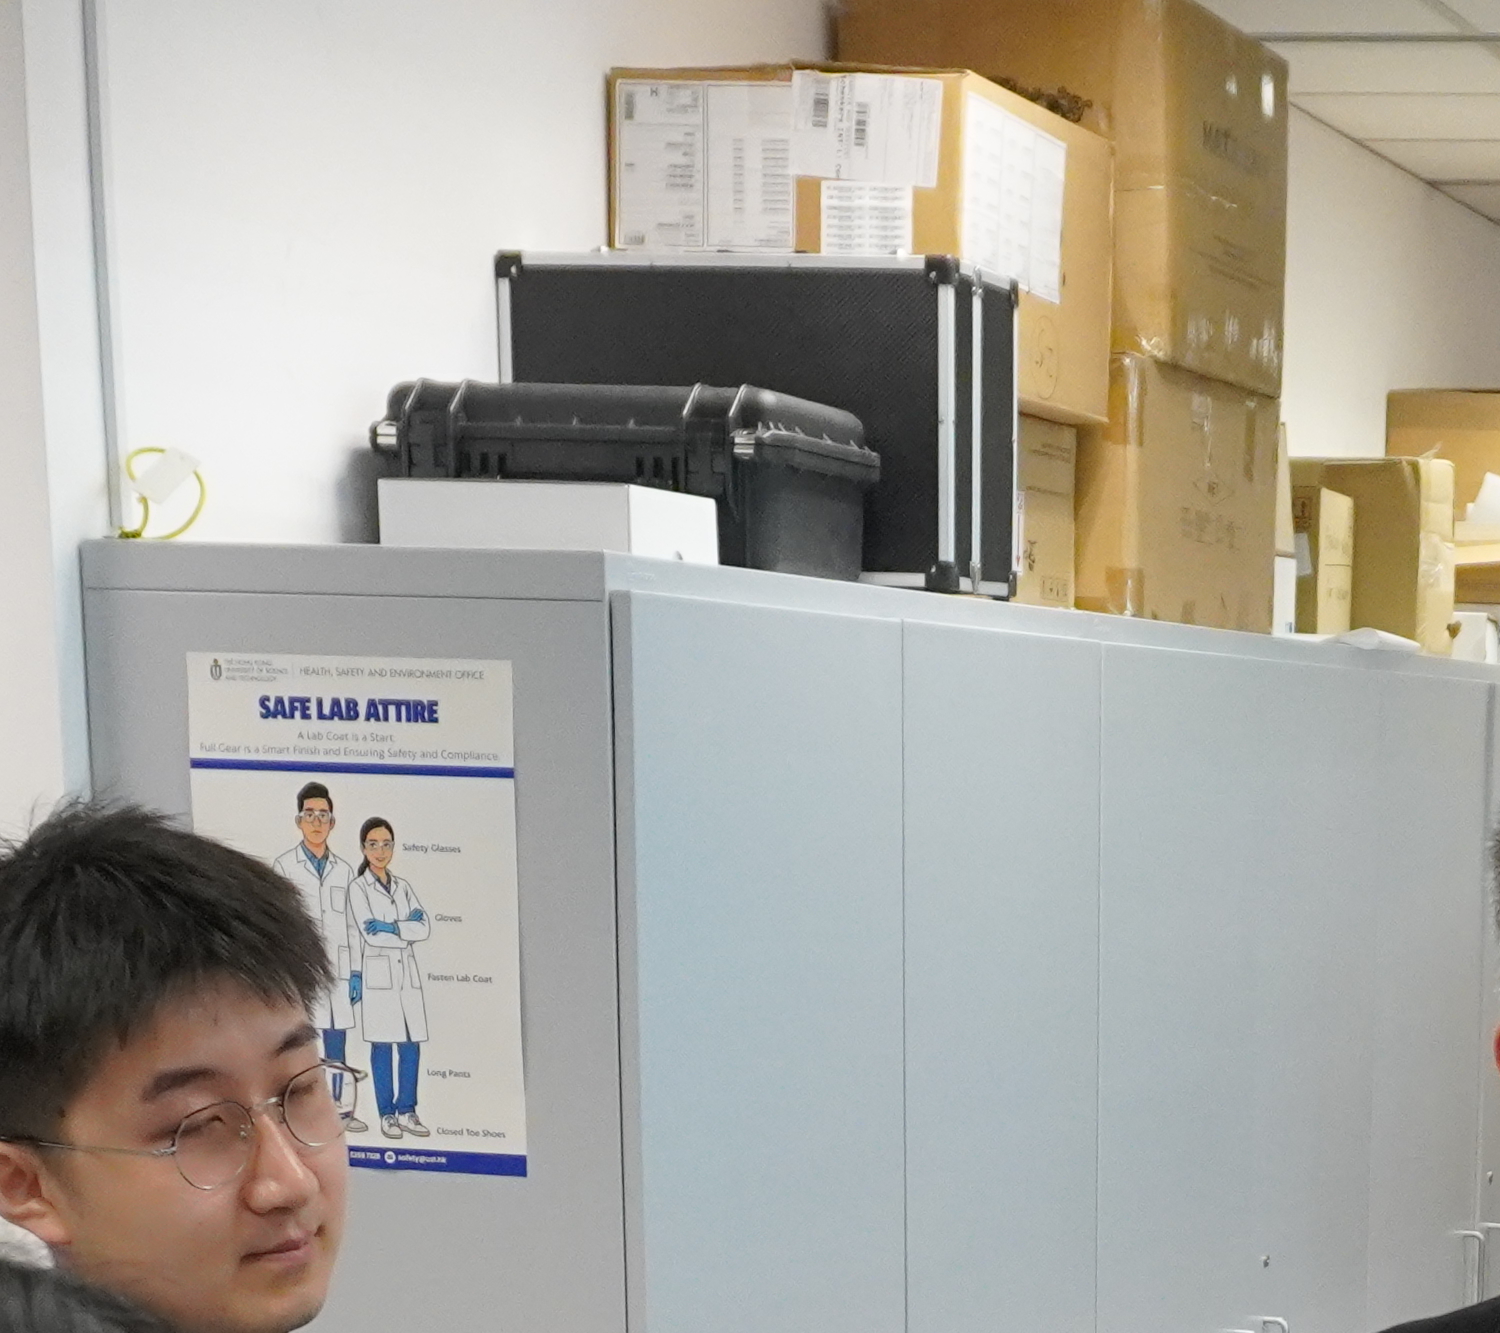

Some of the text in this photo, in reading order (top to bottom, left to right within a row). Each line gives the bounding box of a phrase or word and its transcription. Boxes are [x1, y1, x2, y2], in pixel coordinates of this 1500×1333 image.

[299, 666, 486, 681] HEALTH, SAFETY AND ENVIRONMENT OFFICE
[258, 695, 440, 724] SAFE LAB ATTIRE
[297, 732, 305, 741] A
[306, 731, 324, 741] Lab
[326, 732, 349, 742] Coat
[218, 743, 241, 754] Gear
[262, 745, 290, 755] Smart
[293, 746, 321, 757] Finish
[323, 747, 342, 757] and
[343, 747, 385, 760] Ensuring
[387, 748, 418, 761] Safety
[420, 749, 439, 760] and
[402, 843, 461, 854] Safety Glasses
[434, 913, 463, 923] Gloves
[427, 972, 493, 984] Fasten Lab Coat
[426, 1068, 471, 1079] Long Pants
[436, 1126, 506, 1139] Closed Toe Shoes
